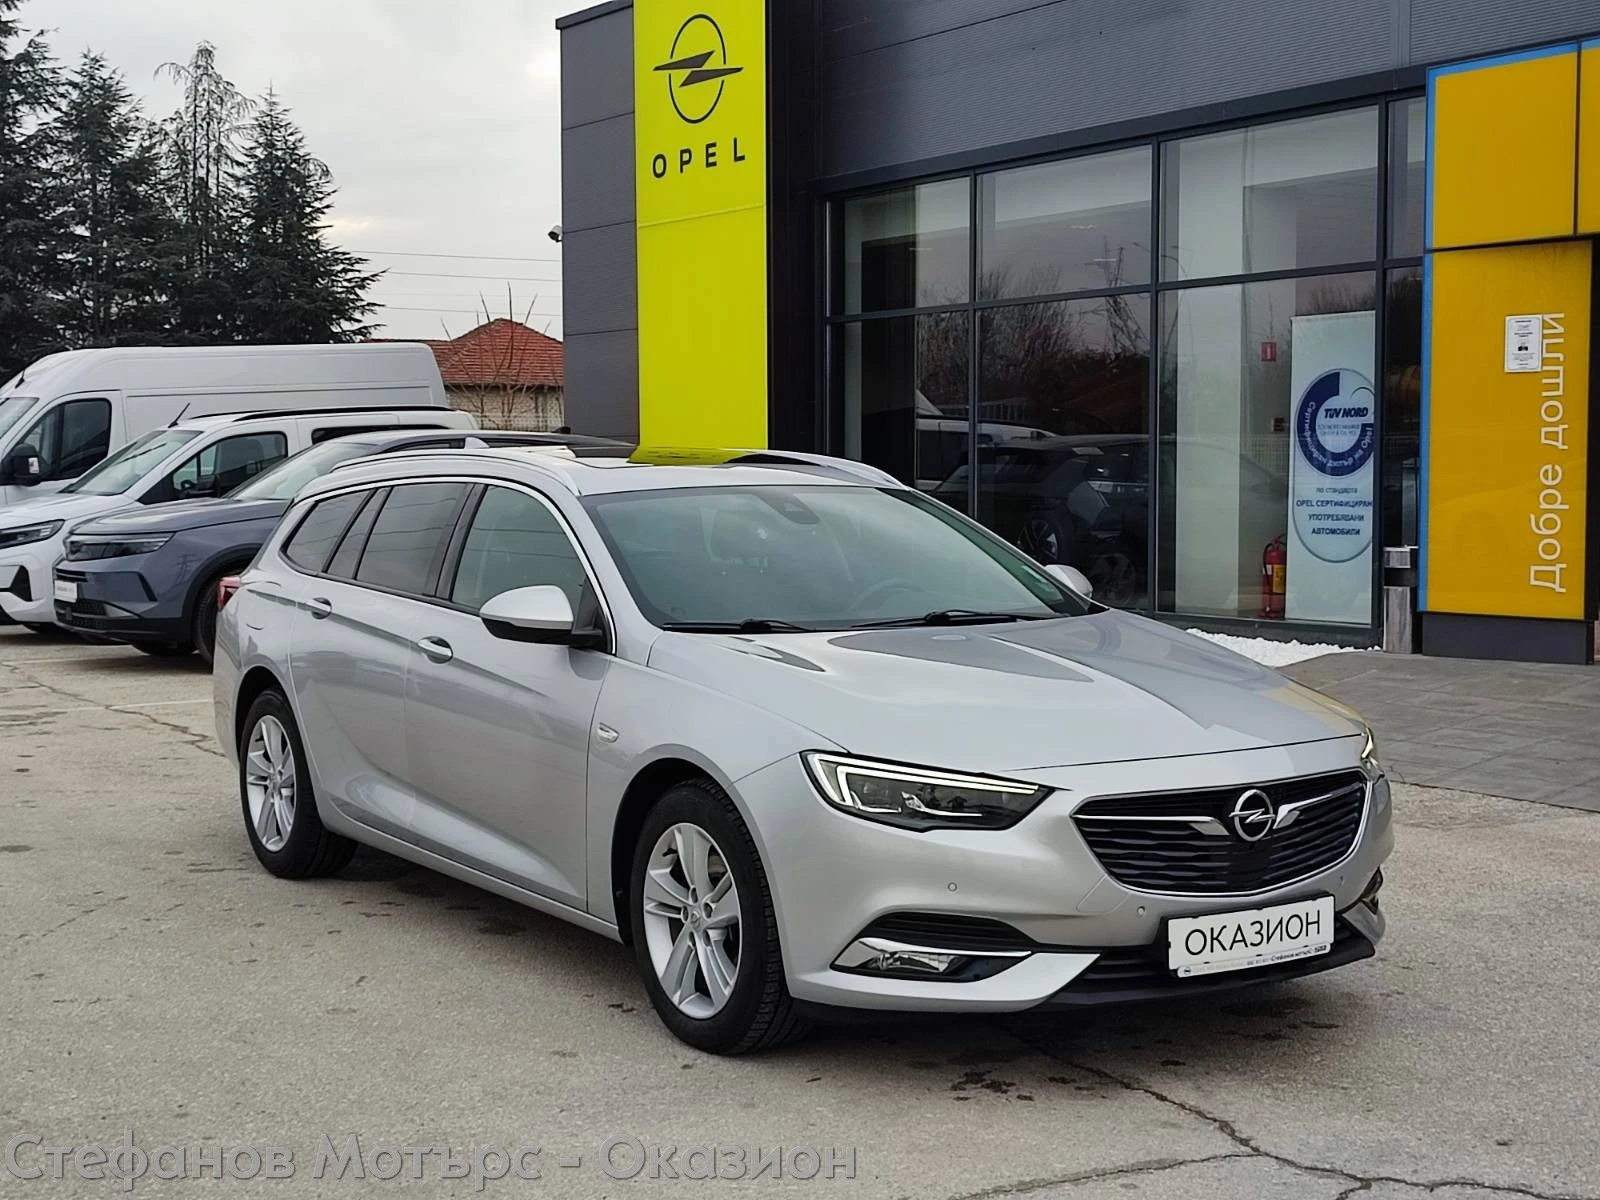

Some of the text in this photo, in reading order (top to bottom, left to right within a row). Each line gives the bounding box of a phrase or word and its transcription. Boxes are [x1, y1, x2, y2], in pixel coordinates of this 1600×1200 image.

[652, 137, 746, 179] OPEL
[1341, 407, 1369, 418] NORD
[1530, 312, 1569, 593] Добре дошли
[1296, 499, 1314, 507] OPEL
[1311, 527, 1361, 536] АВТОМОБИЛИ
[1185, 909, 1321, 956] ОКАЗИОН
